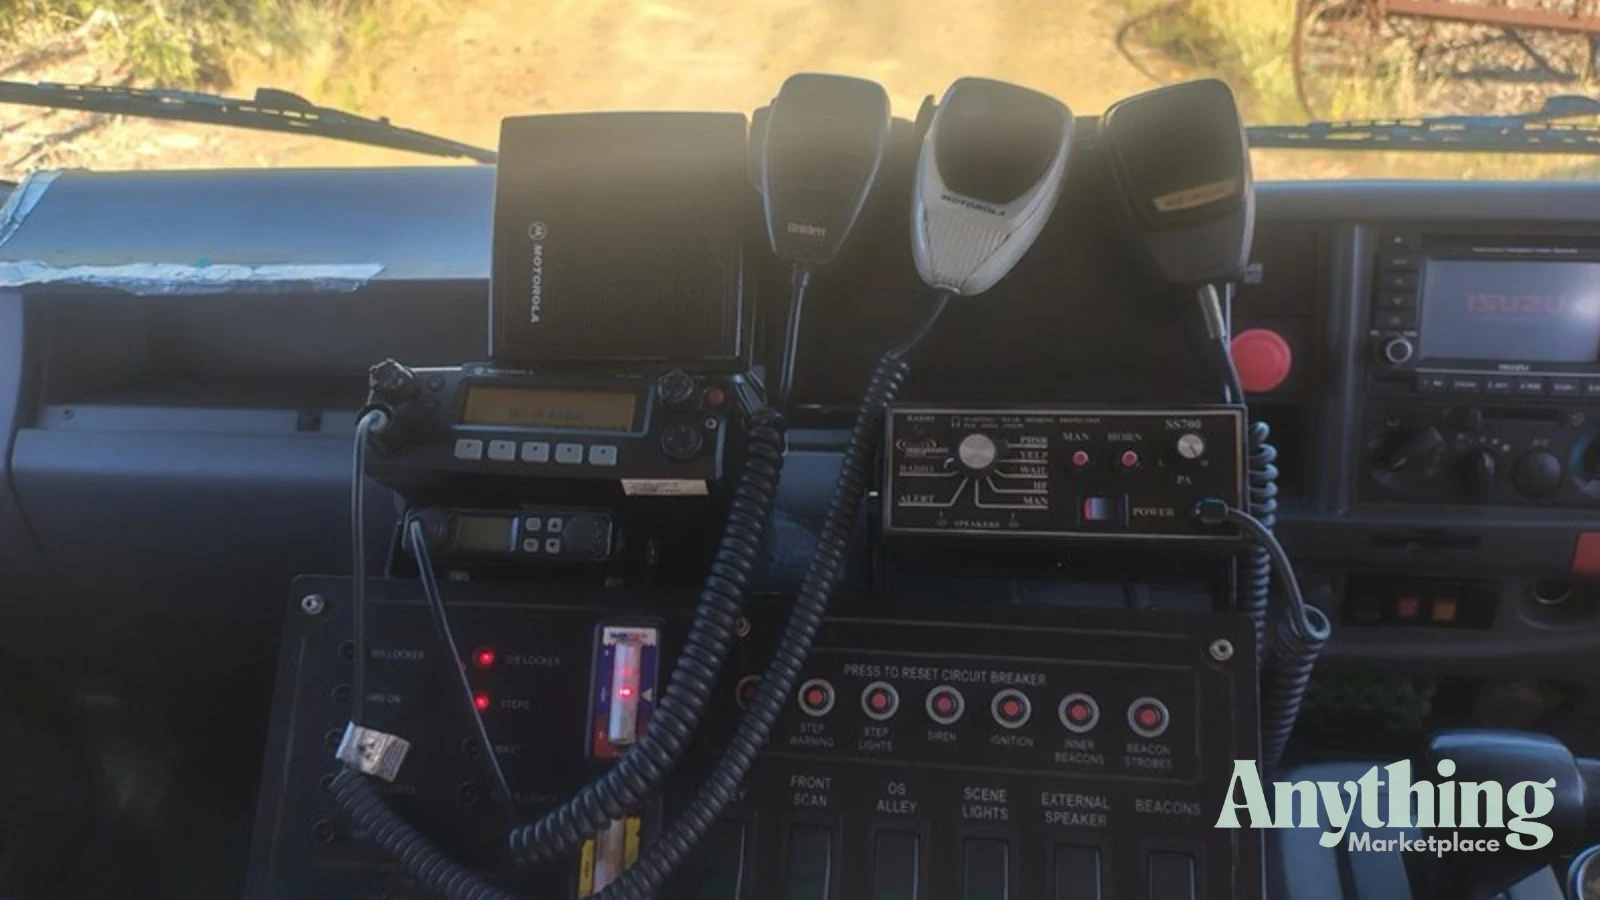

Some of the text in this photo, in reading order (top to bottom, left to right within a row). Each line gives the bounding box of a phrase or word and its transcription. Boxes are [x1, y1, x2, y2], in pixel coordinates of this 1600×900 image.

[942, 193, 1006, 217] MOTOROLA
[530, 244, 544, 323] MOTOROLA
[1165, 418, 1203, 430] SS700
[1062, 431, 1090, 442] MAN
[1107, 431, 1143, 442] HORN
[1176, 475, 1193, 486] PA
[900, 494, 934, 505] ALERT
[1023, 496, 1048, 506] MAN
[1132, 507, 1175, 517] POWER
[843, 663, 1047, 686] PRESS TO RESET CIRCUIT BREAKER
[800, 722, 825, 734] STEP
[864, 726, 889, 738] STEP
[790, 735, 834, 748] WARNING
[927, 730, 957, 743] SIREN
[989, 734, 1034, 748] IGNITION
[858, 739, 893, 752] LIGHTS
[1063, 739, 1095, 751] INNER
[1126, 743, 1171, 756] BEACON
[1054, 751, 1104, 765] BEACONS
[1124, 755, 1173, 770] STROBES
[790, 775, 832, 790] FRONT
[887, 782, 907, 797] OS
[793, 792, 828, 808] SCAN
[963, 786, 1008, 803] SCENE
[1041, 792, 1110, 811] EXTERNAL
[876, 799, 917, 815] ALLEY
[962, 804, 1009, 822] LIGHTS
[1135, 798, 1201, 816] BEACONS
[1044, 810, 1107, 828] SPEAKER
